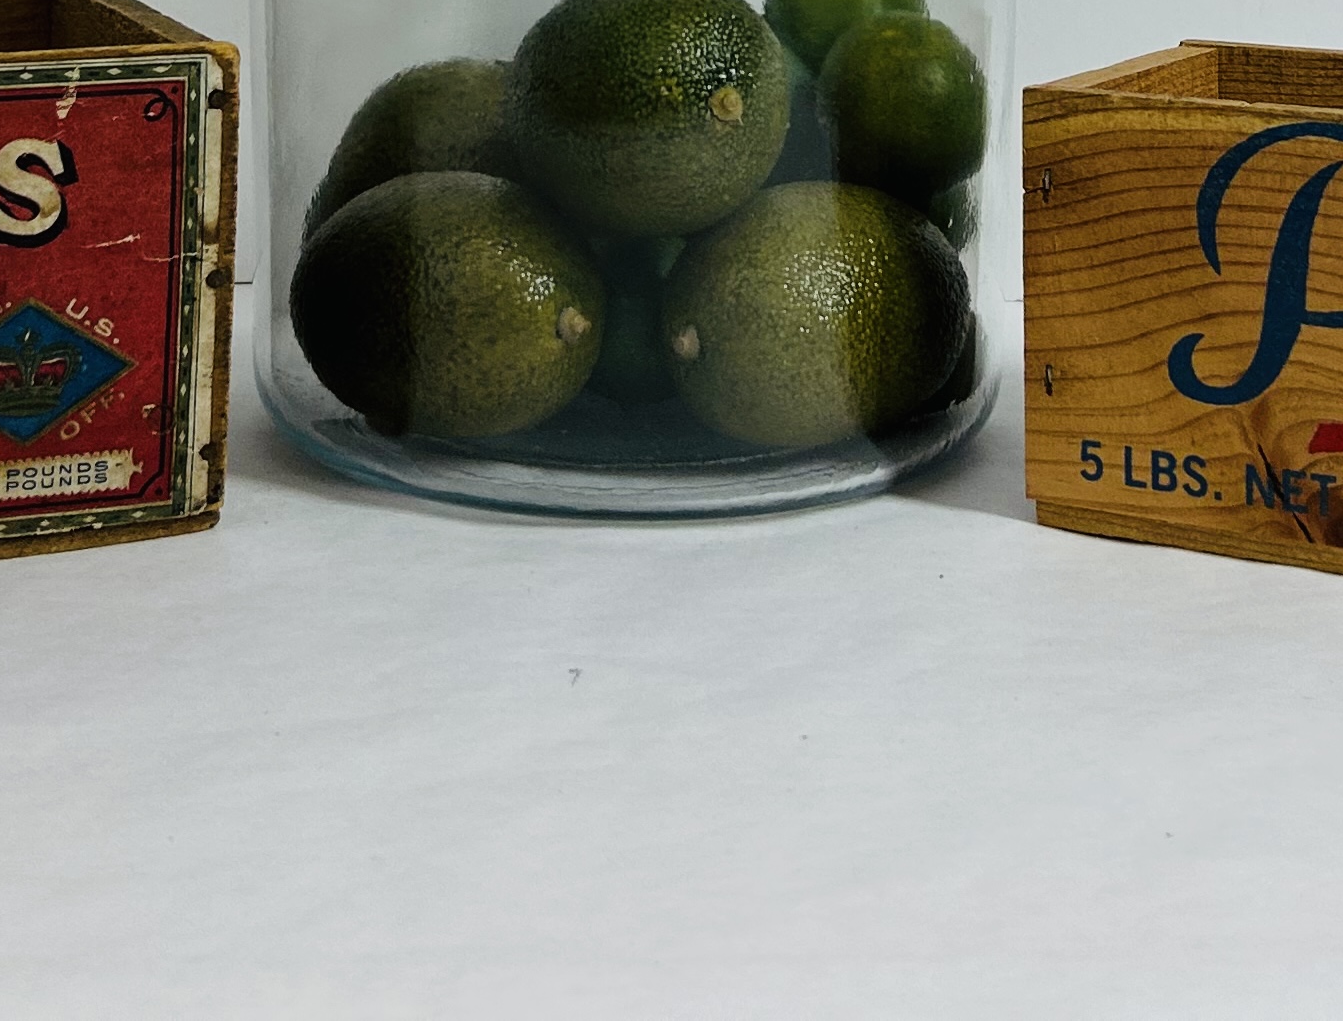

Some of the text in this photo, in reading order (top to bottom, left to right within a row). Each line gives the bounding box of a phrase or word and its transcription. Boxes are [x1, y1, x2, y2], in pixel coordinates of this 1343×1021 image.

[65, 297, 120, 345] U.S.
[59, 387, 125, 441] OFF.
[5, 472, 108, 492] POUNDS
[6, 460, 109, 480] POUNDS
[1079, 439, 1337, 517] 5 LBS. NET
